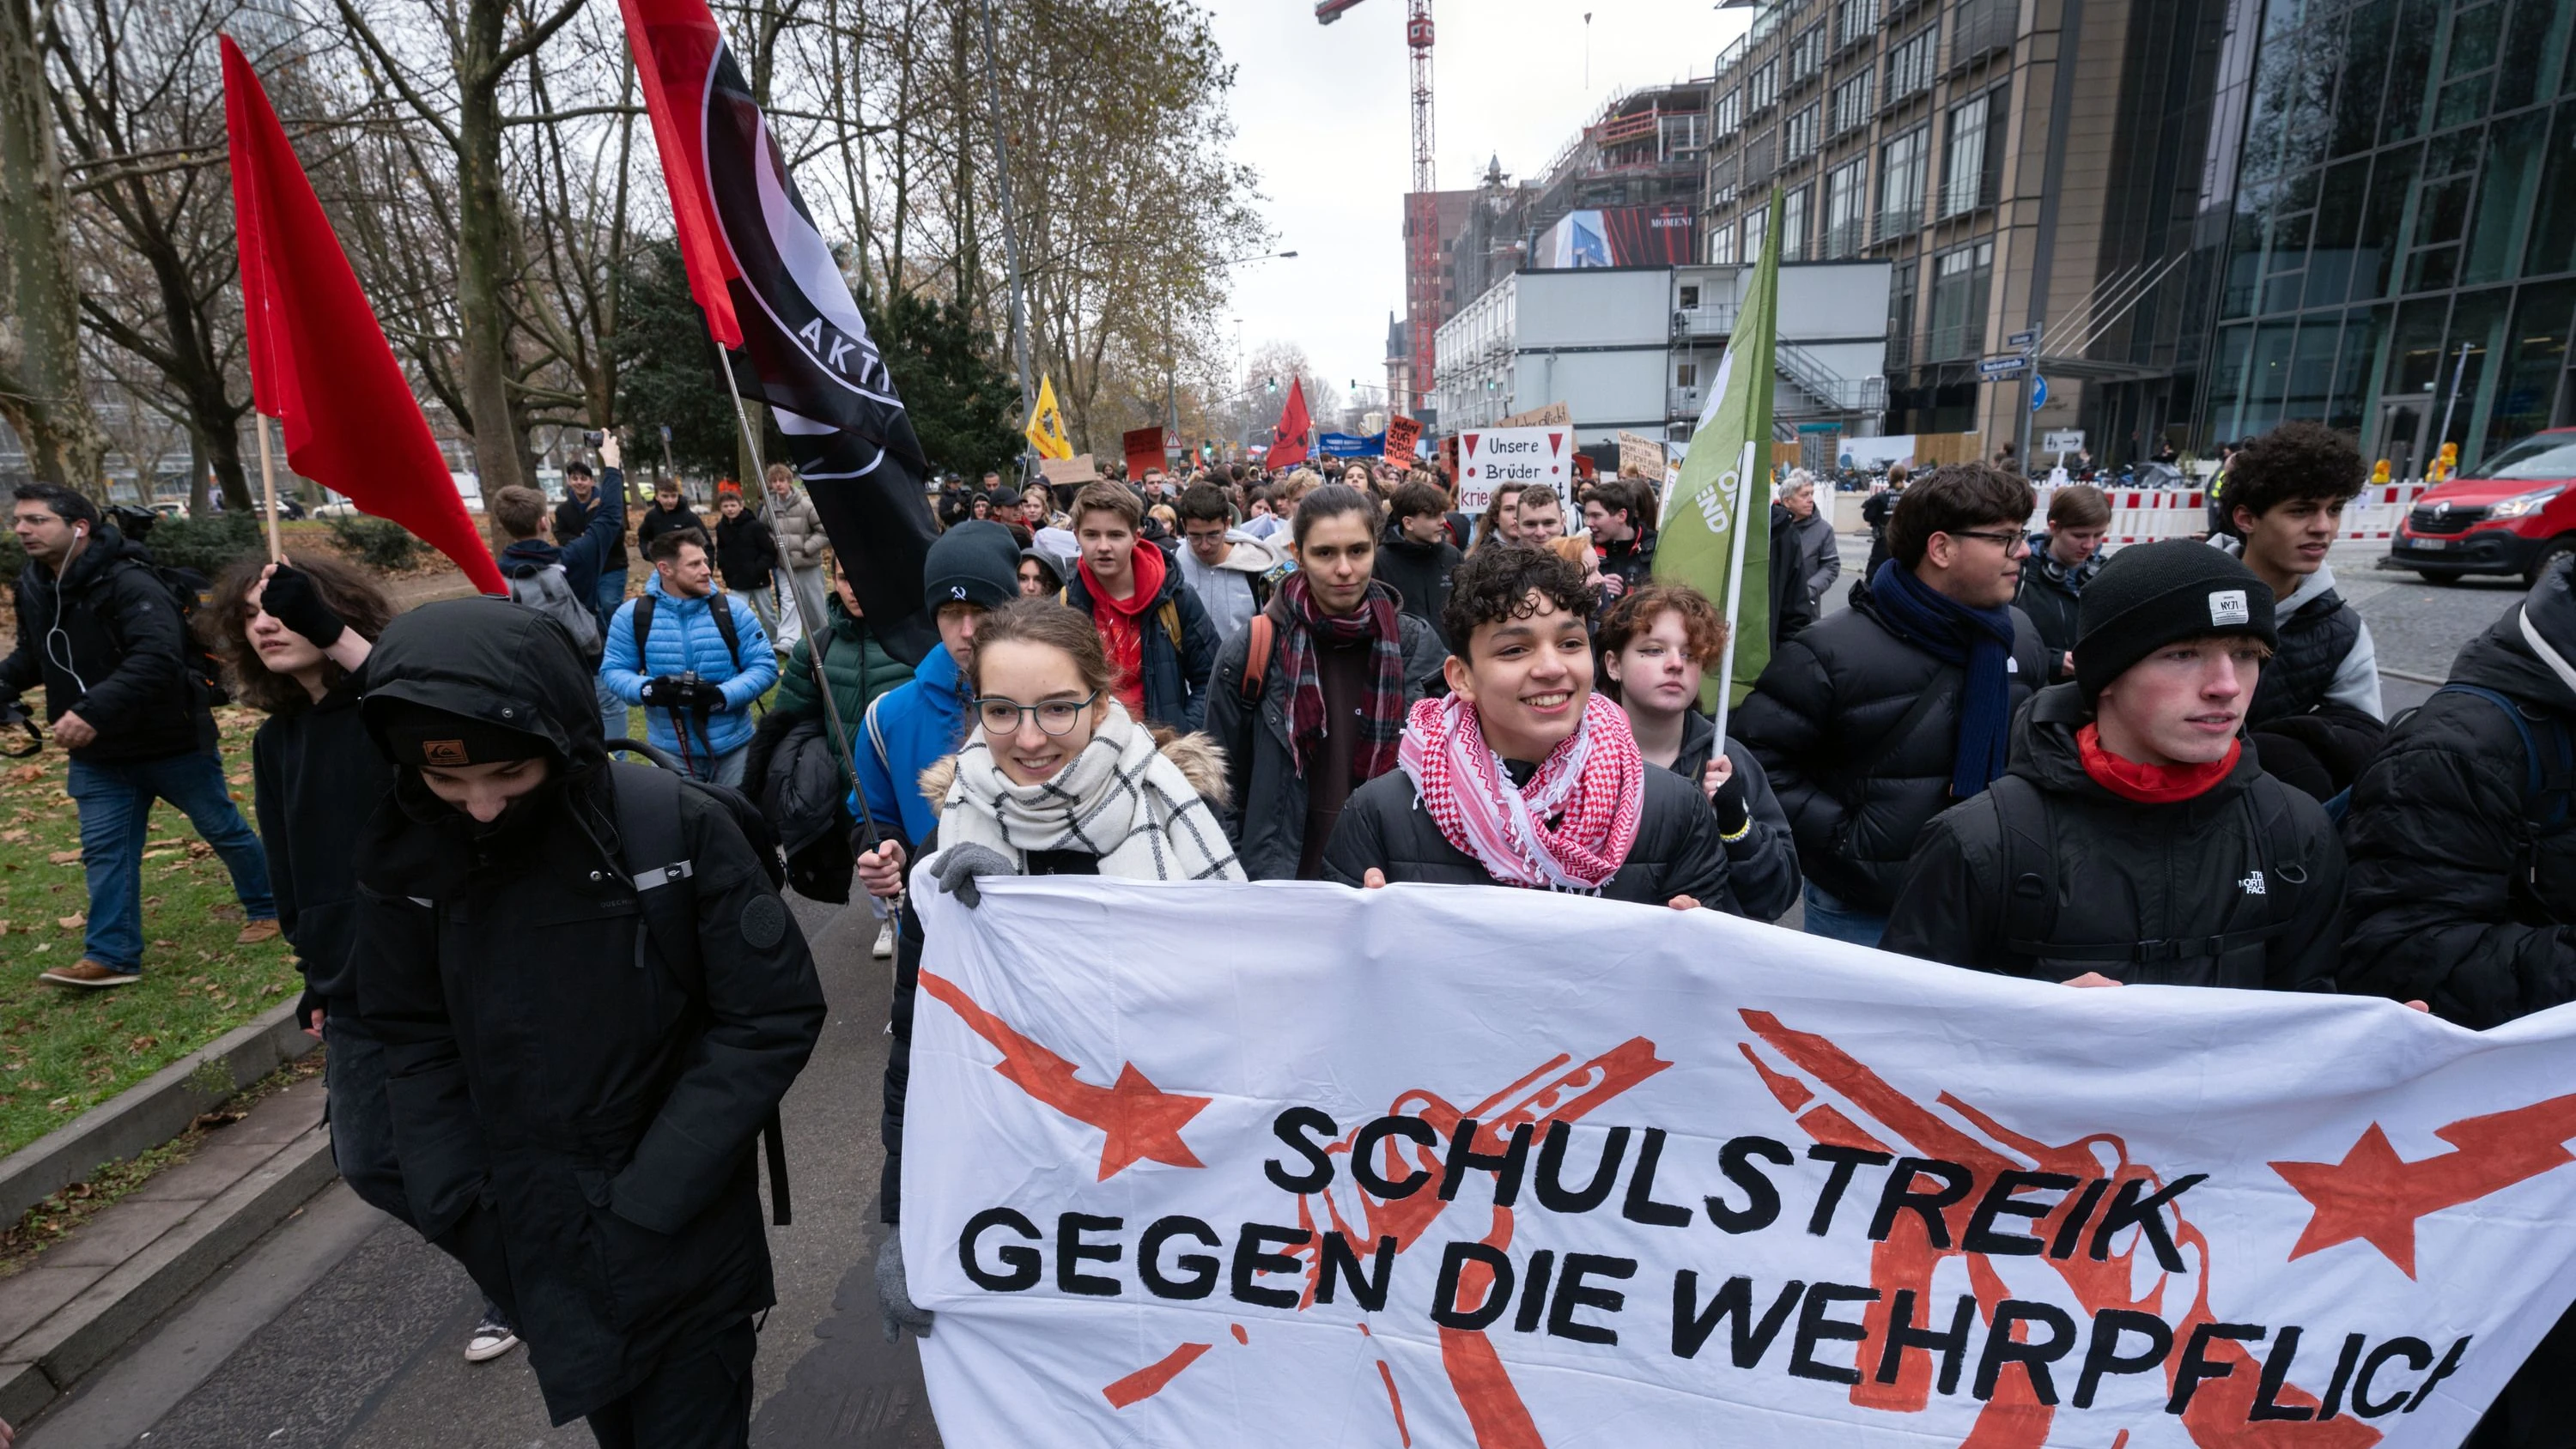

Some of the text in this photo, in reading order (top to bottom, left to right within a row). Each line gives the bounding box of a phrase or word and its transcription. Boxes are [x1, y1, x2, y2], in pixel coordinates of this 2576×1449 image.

[1490, 437, 1539, 454] Unsere
[1485, 464, 1541, 479] Brüder
[1461, 487, 1493, 506] krie
[1265, 1106, 2209, 1274] SCHULSTREIK
[958, 1206, 1398, 1313] GEGEN
[1430, 1240, 1639, 1347] DIE
